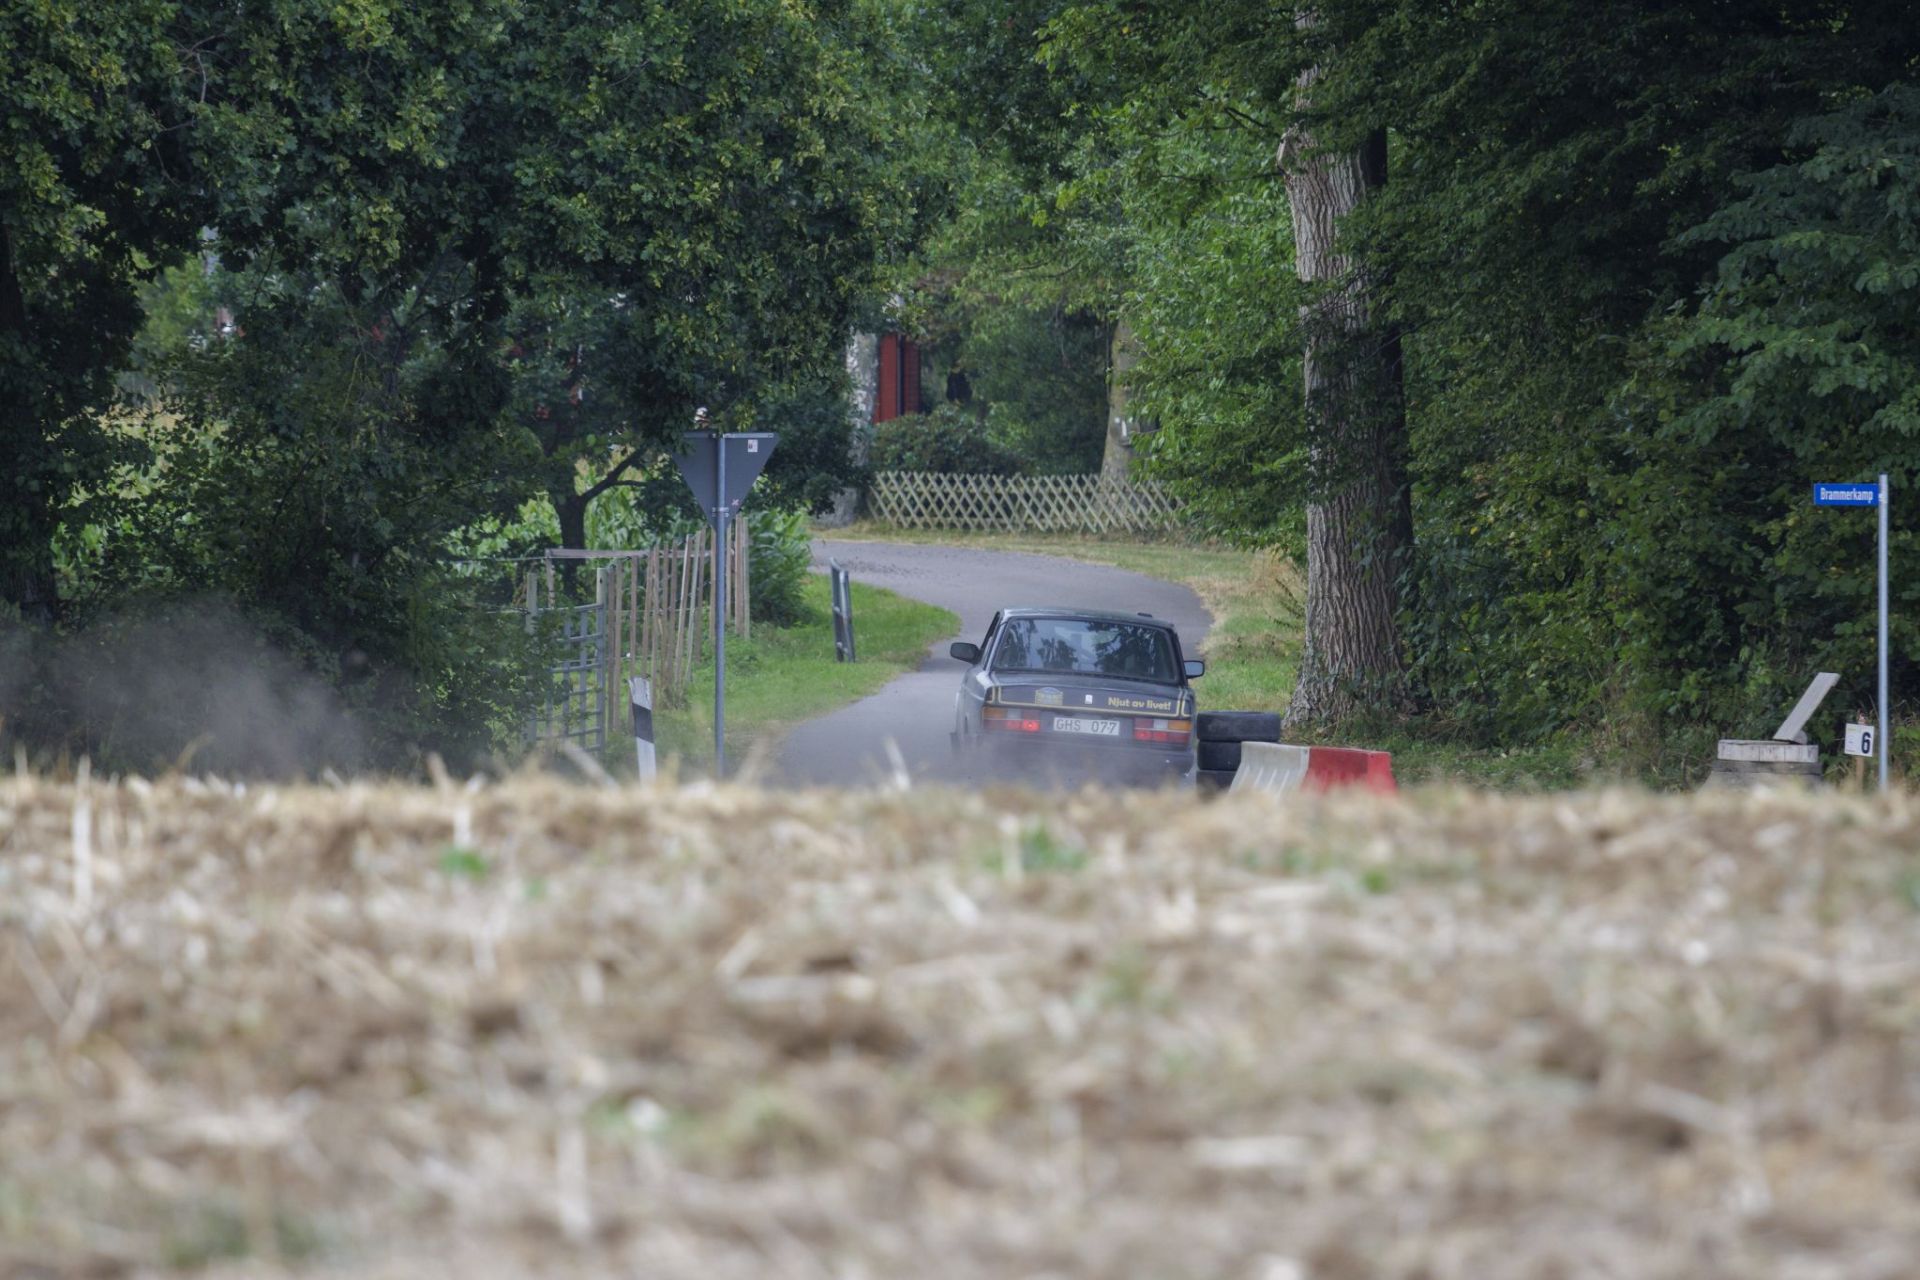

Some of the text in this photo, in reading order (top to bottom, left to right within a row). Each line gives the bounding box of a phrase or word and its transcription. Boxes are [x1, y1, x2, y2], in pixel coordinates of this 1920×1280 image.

[1820, 487, 1873, 504] Brammerkamp
[1108, 697, 1130, 707] Njut
[1056, 719, 1117, 734] GHS 077
[1862, 732, 1871, 754] 6
